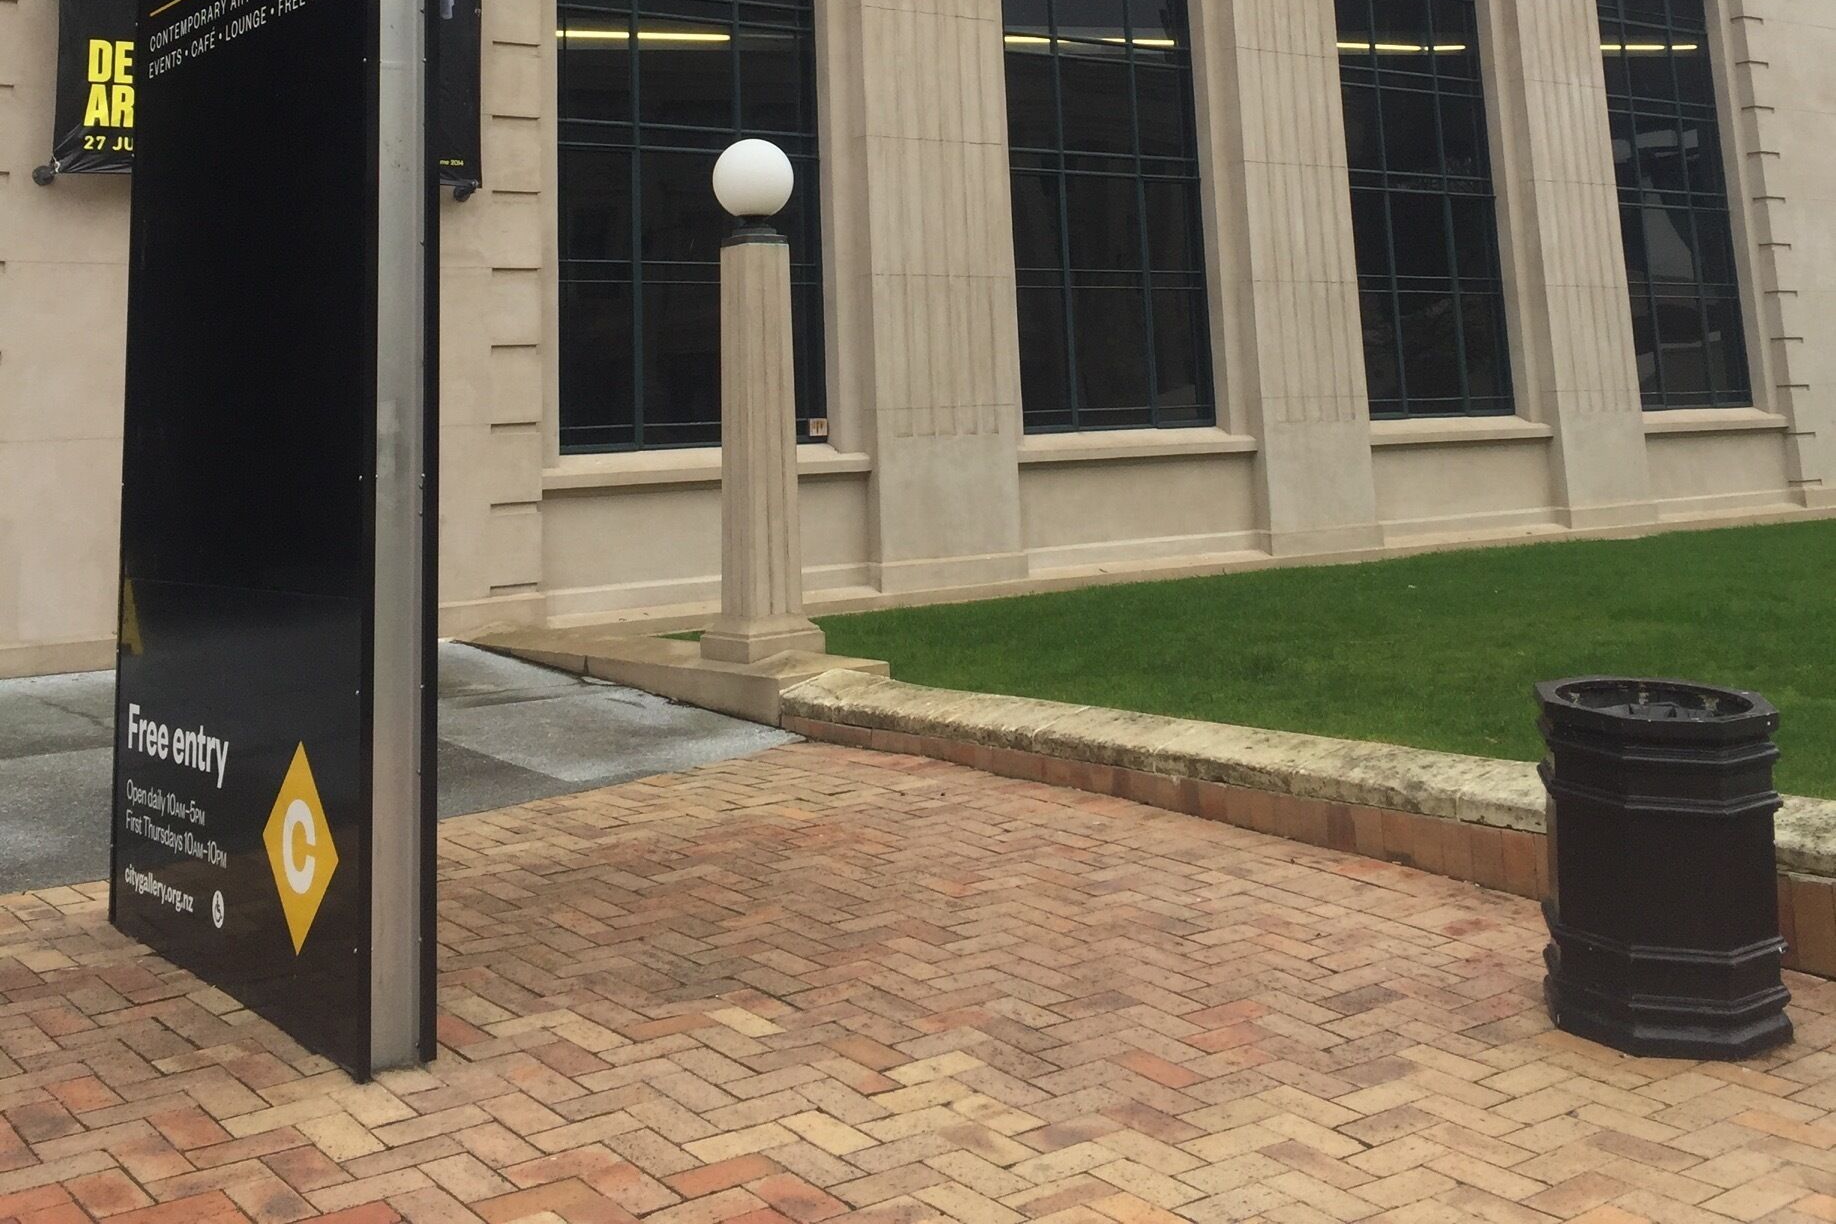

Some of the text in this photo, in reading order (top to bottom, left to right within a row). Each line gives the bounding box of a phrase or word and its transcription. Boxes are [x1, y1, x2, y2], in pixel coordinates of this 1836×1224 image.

[148, 48, 183, 79] EVENTS
[190, 26, 216, 58] CAFÉ
[225, 5, 268, 42] LOUNGE
[83, 135, 107, 151] 27
[127, 702, 229, 789] Free entry
[126, 778, 147, 807] Open
[147, 787, 166, 817] daily
[125, 809, 143, 835] First
[143, 815, 184, 855] Thursdays
[282, 798, 316, 895] C
[124, 863, 194, 913] citygallery.org.nz
